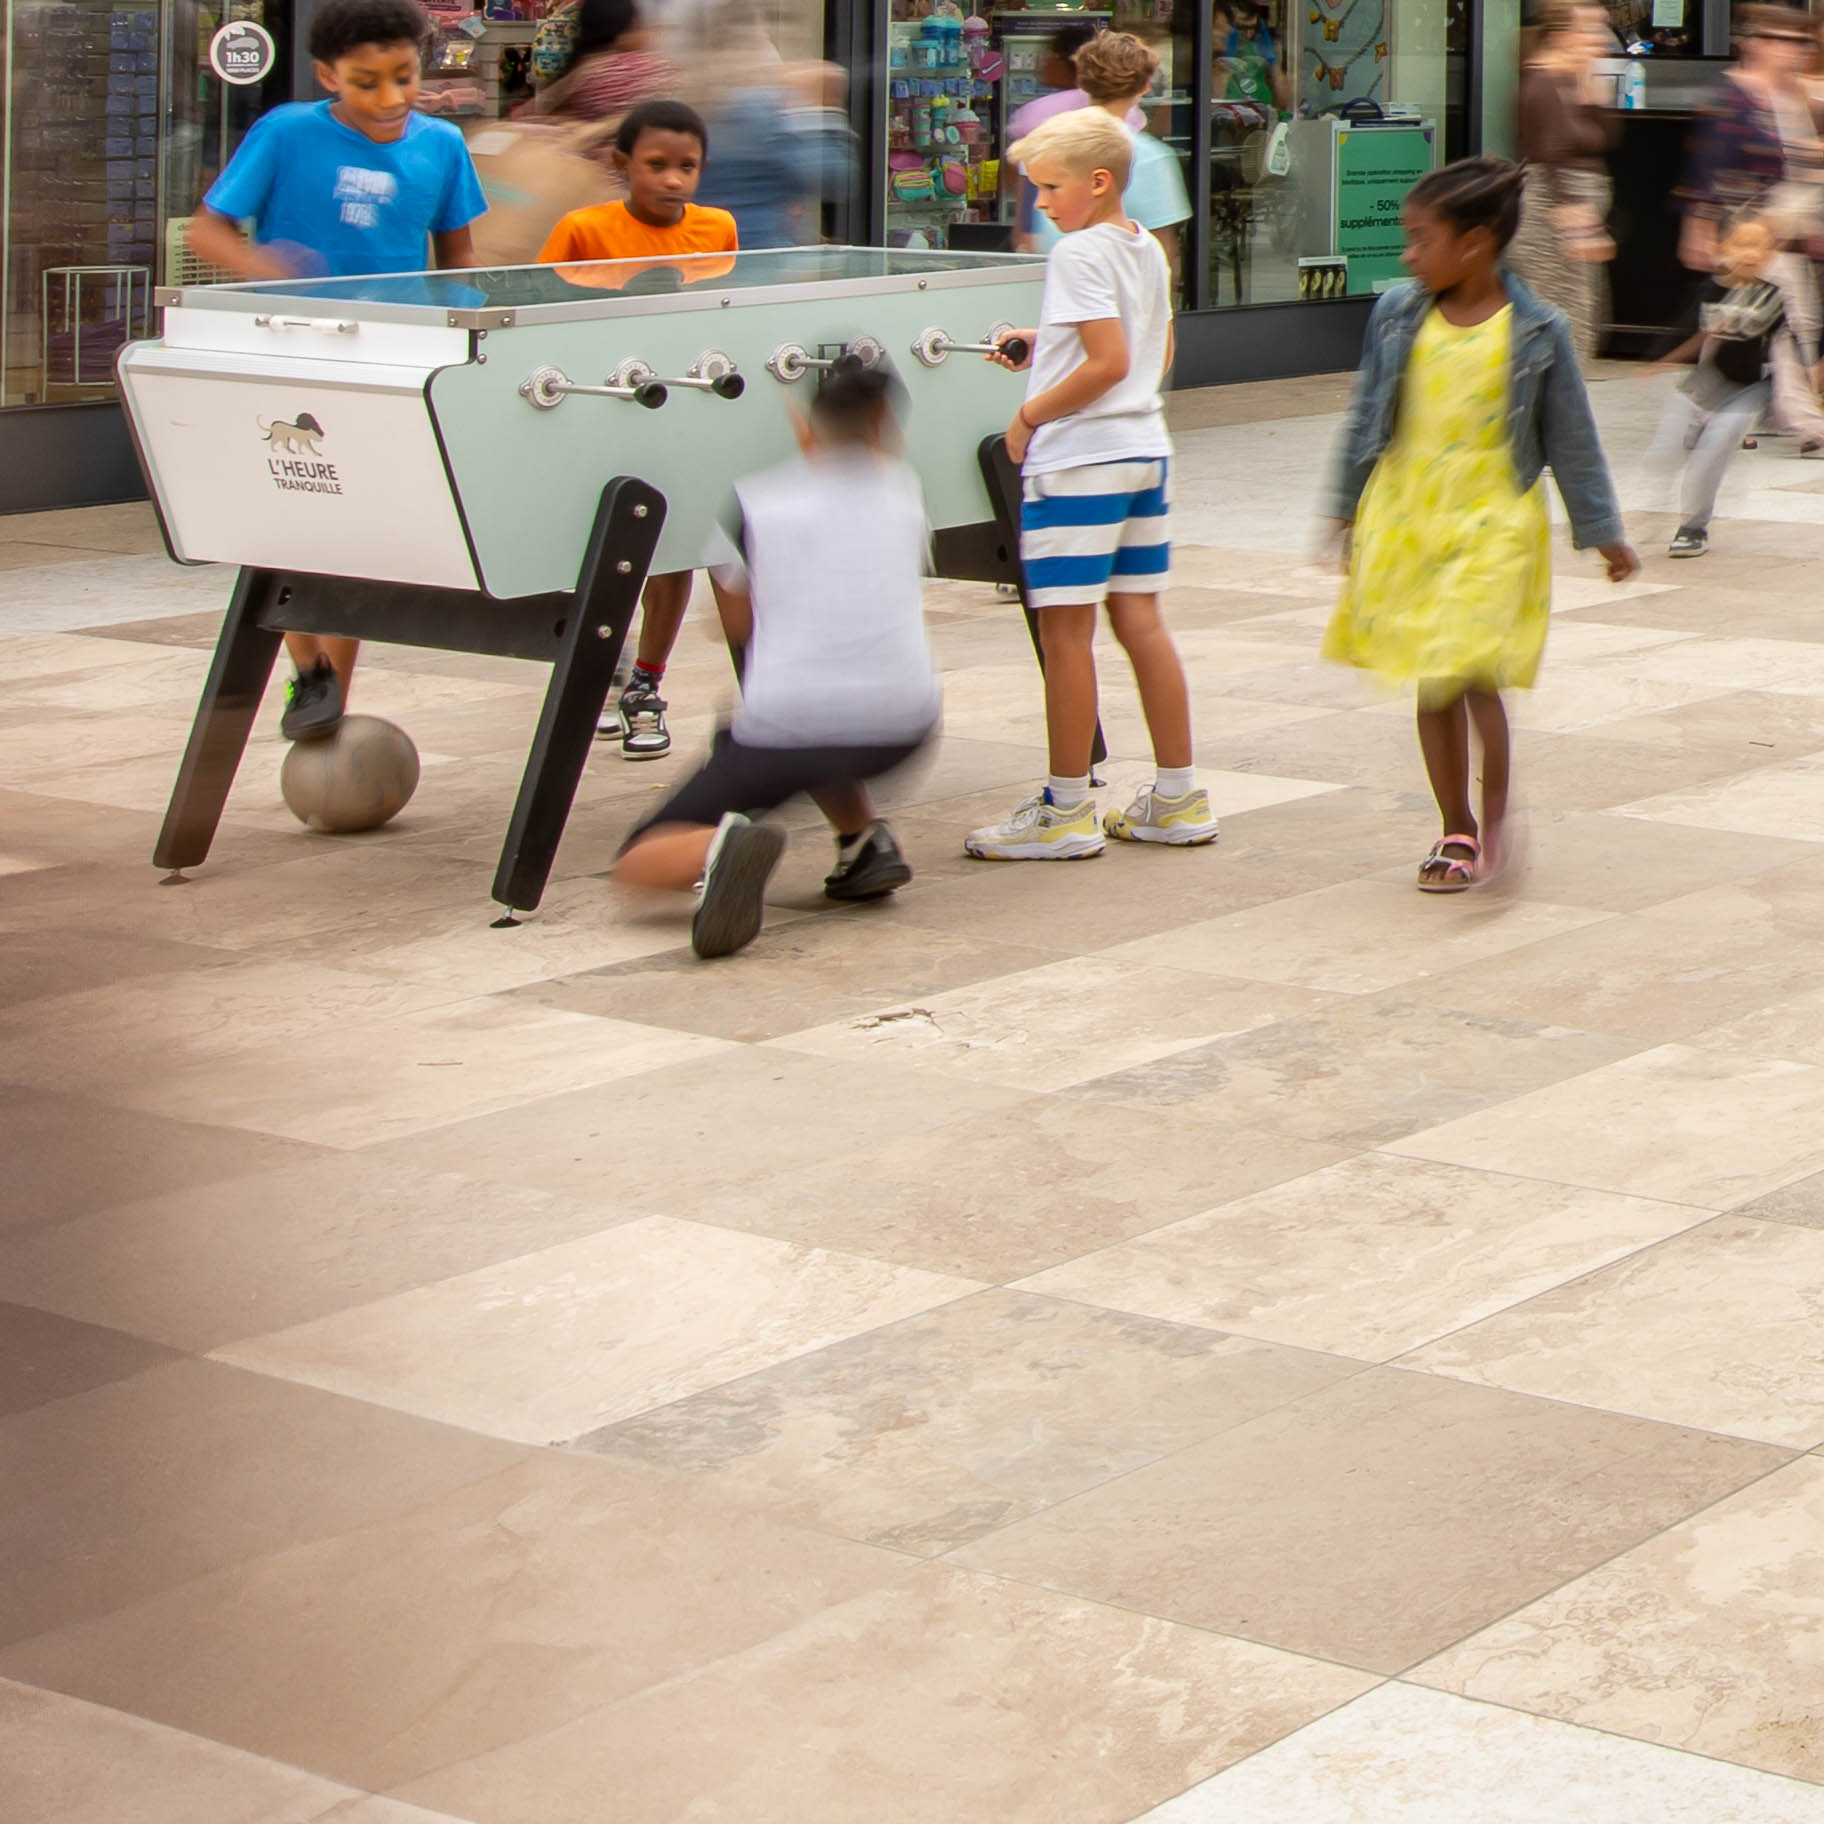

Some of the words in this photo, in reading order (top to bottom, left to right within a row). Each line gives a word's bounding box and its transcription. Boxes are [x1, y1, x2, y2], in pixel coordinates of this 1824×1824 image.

[226, 51, 260, 65] 1h30
[268, 458, 339, 480] L'HEURE
[274, 477, 344, 495] TRANQUILLE
